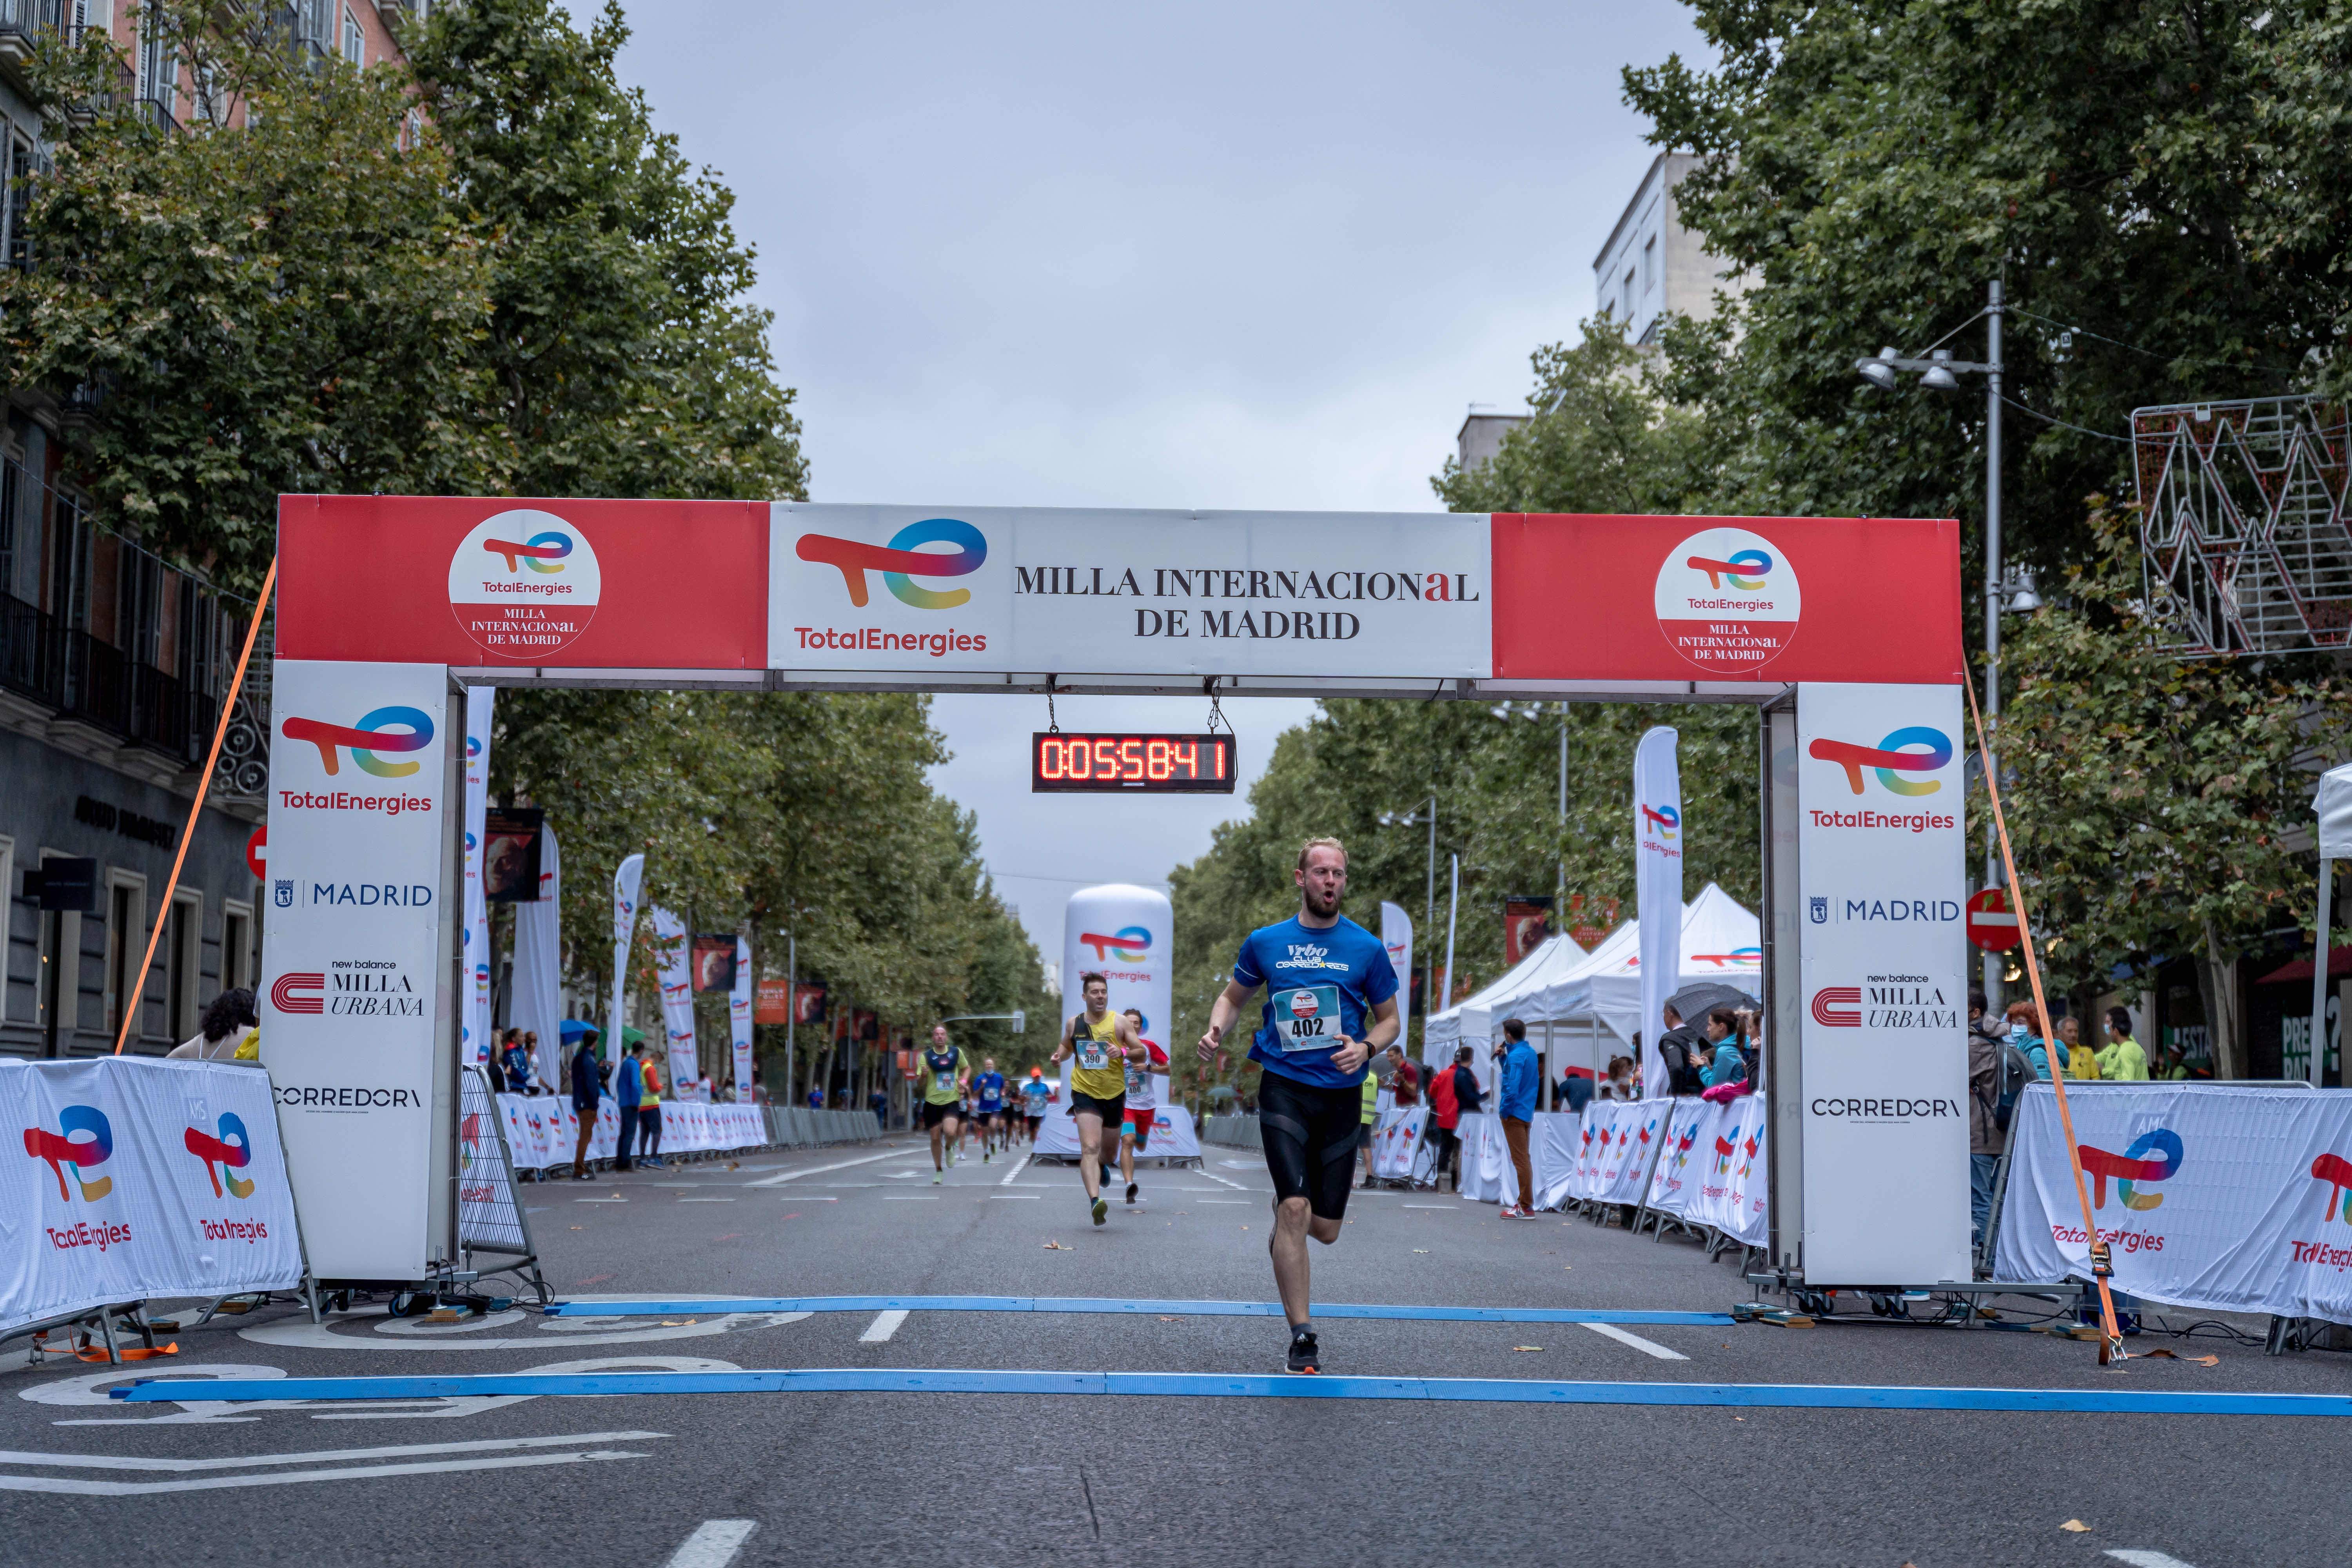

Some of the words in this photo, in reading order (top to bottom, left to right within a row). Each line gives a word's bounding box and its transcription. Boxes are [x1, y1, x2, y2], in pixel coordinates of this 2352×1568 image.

[483, 582, 572, 595] TotalEnergies
[1014, 567, 1144, 596] MILLA
[1687, 599, 1773, 612] TotalEnergies
[504, 608, 546, 619] MILLA
[1134, 609, 1189, 637] DE
[1201, 610, 1360, 640] MADRID
[1710, 624, 1750, 634] MILLA
[487, 634, 505, 644] DE
[509, 635, 561, 645] MADRID
[794, 627, 986, 657] TotalEnergies
[1695, 650, 1712, 659] DE
[1715, 650, 1765, 660] MADRID
[279, 791, 432, 815] TotalEnergies
[1809, 810, 1954, 833] TotalEnergies
[314, 884, 432, 906] MADRID
[1847, 900, 1959, 921] MADRID
[1287, 944, 1328, 956] Vrbo
[354, 960, 396, 969] balance
[332, 974, 414, 993] MILLA
[1079, 970, 1151, 983] TlEnergies
[1889, 974, 1929, 983] balance
[1868, 987, 1945, 1005] MILLA
[332, 997, 424, 1016] URBANA
[1869, 1010, 1958, 1028] URBANA
[1292, 1018, 1325, 1038] 402
[1085, 1055, 1100, 1063] 390
[1129, 1086, 1141, 1094] 400
